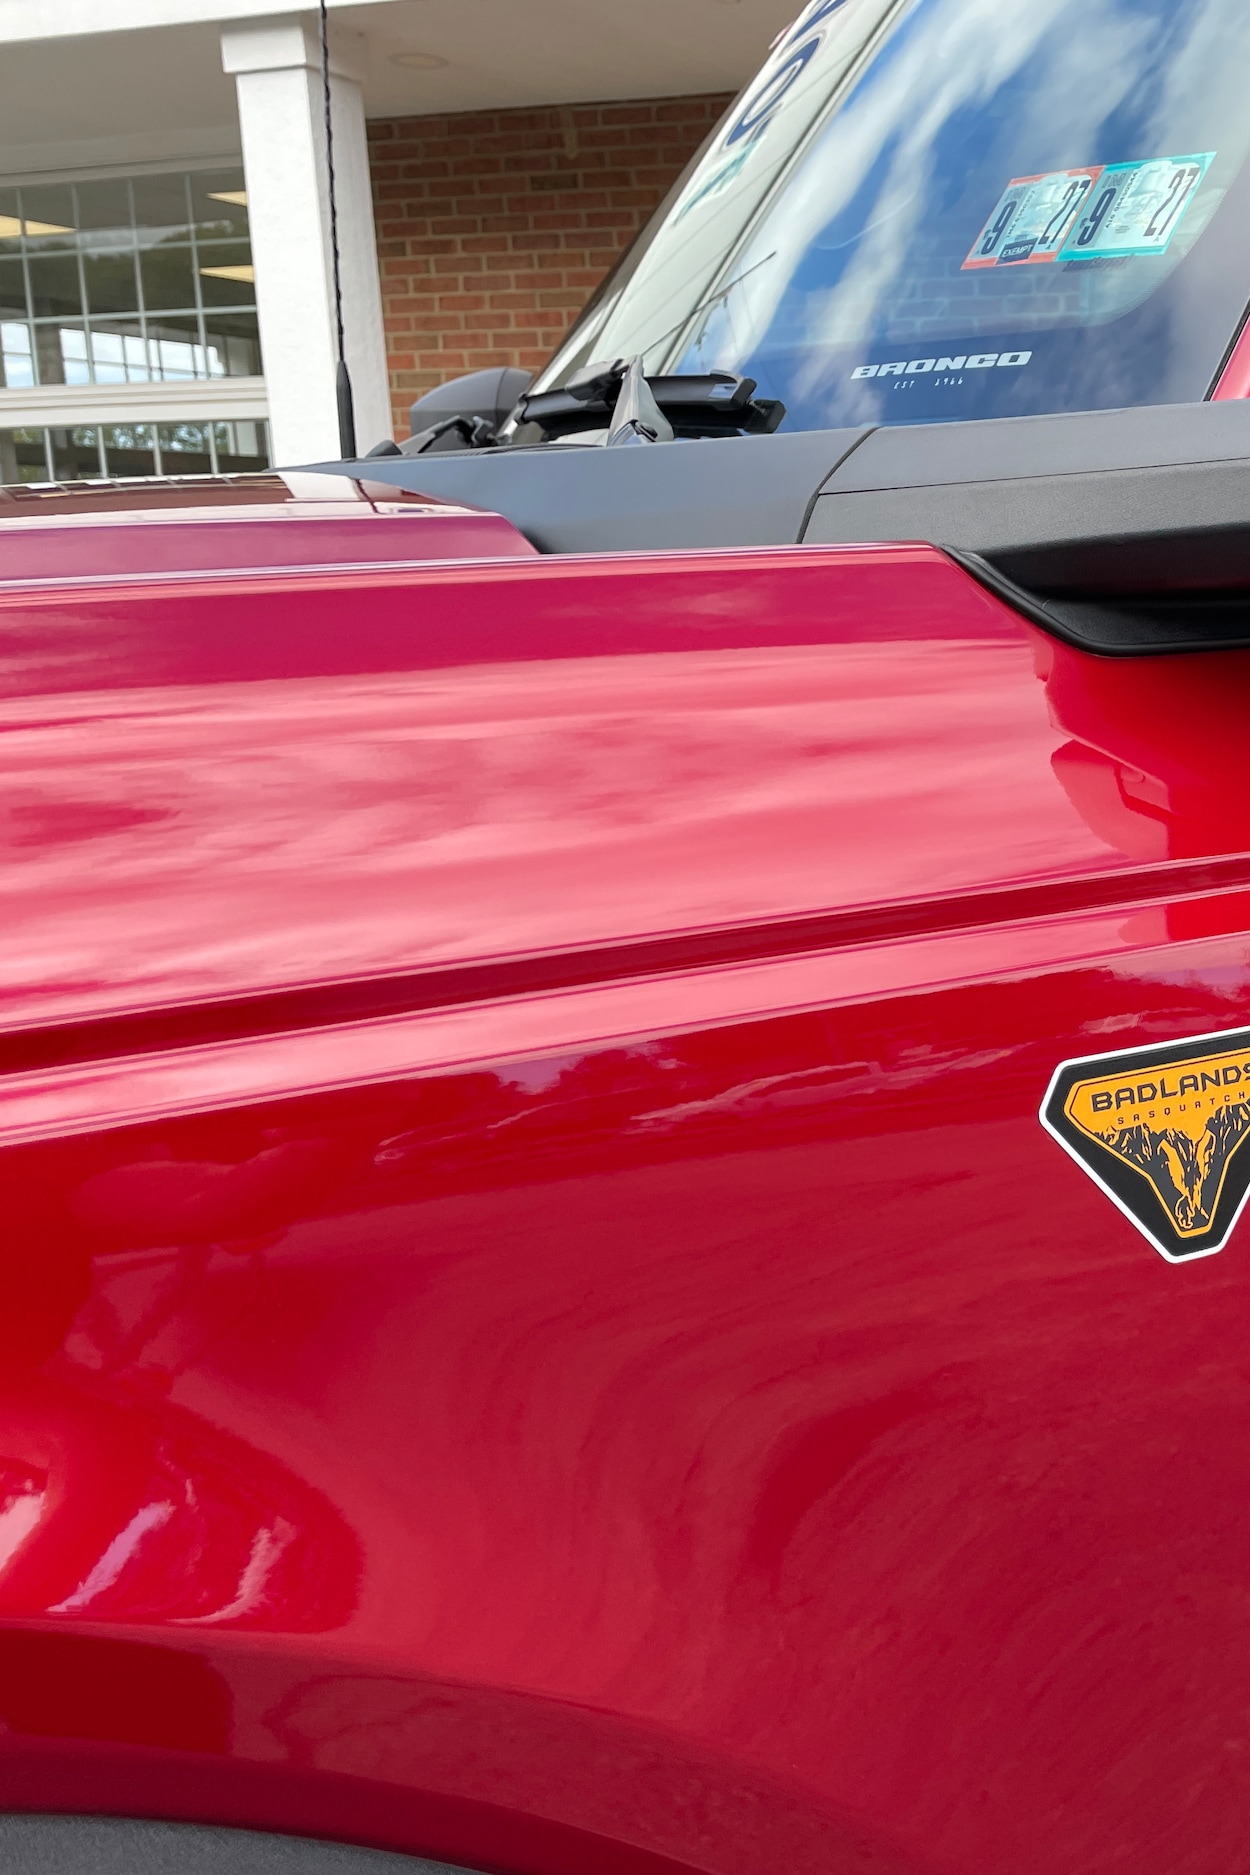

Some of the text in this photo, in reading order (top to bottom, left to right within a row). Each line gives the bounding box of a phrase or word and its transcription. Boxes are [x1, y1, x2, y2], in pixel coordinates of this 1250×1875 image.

[1038, 180, 1091, 244] 27
[1077, 188, 1116, 245] 9
[1143, 167, 1200, 236] 27
[981, 201, 1017, 254] 9
[1001, 243, 1034, 258] EXEMPT
[851, 351, 1033, 380] BRONCO
[894, 376, 964, 389] EST 1966
[1117, 1091, 1246, 1125] SASQUATCH
